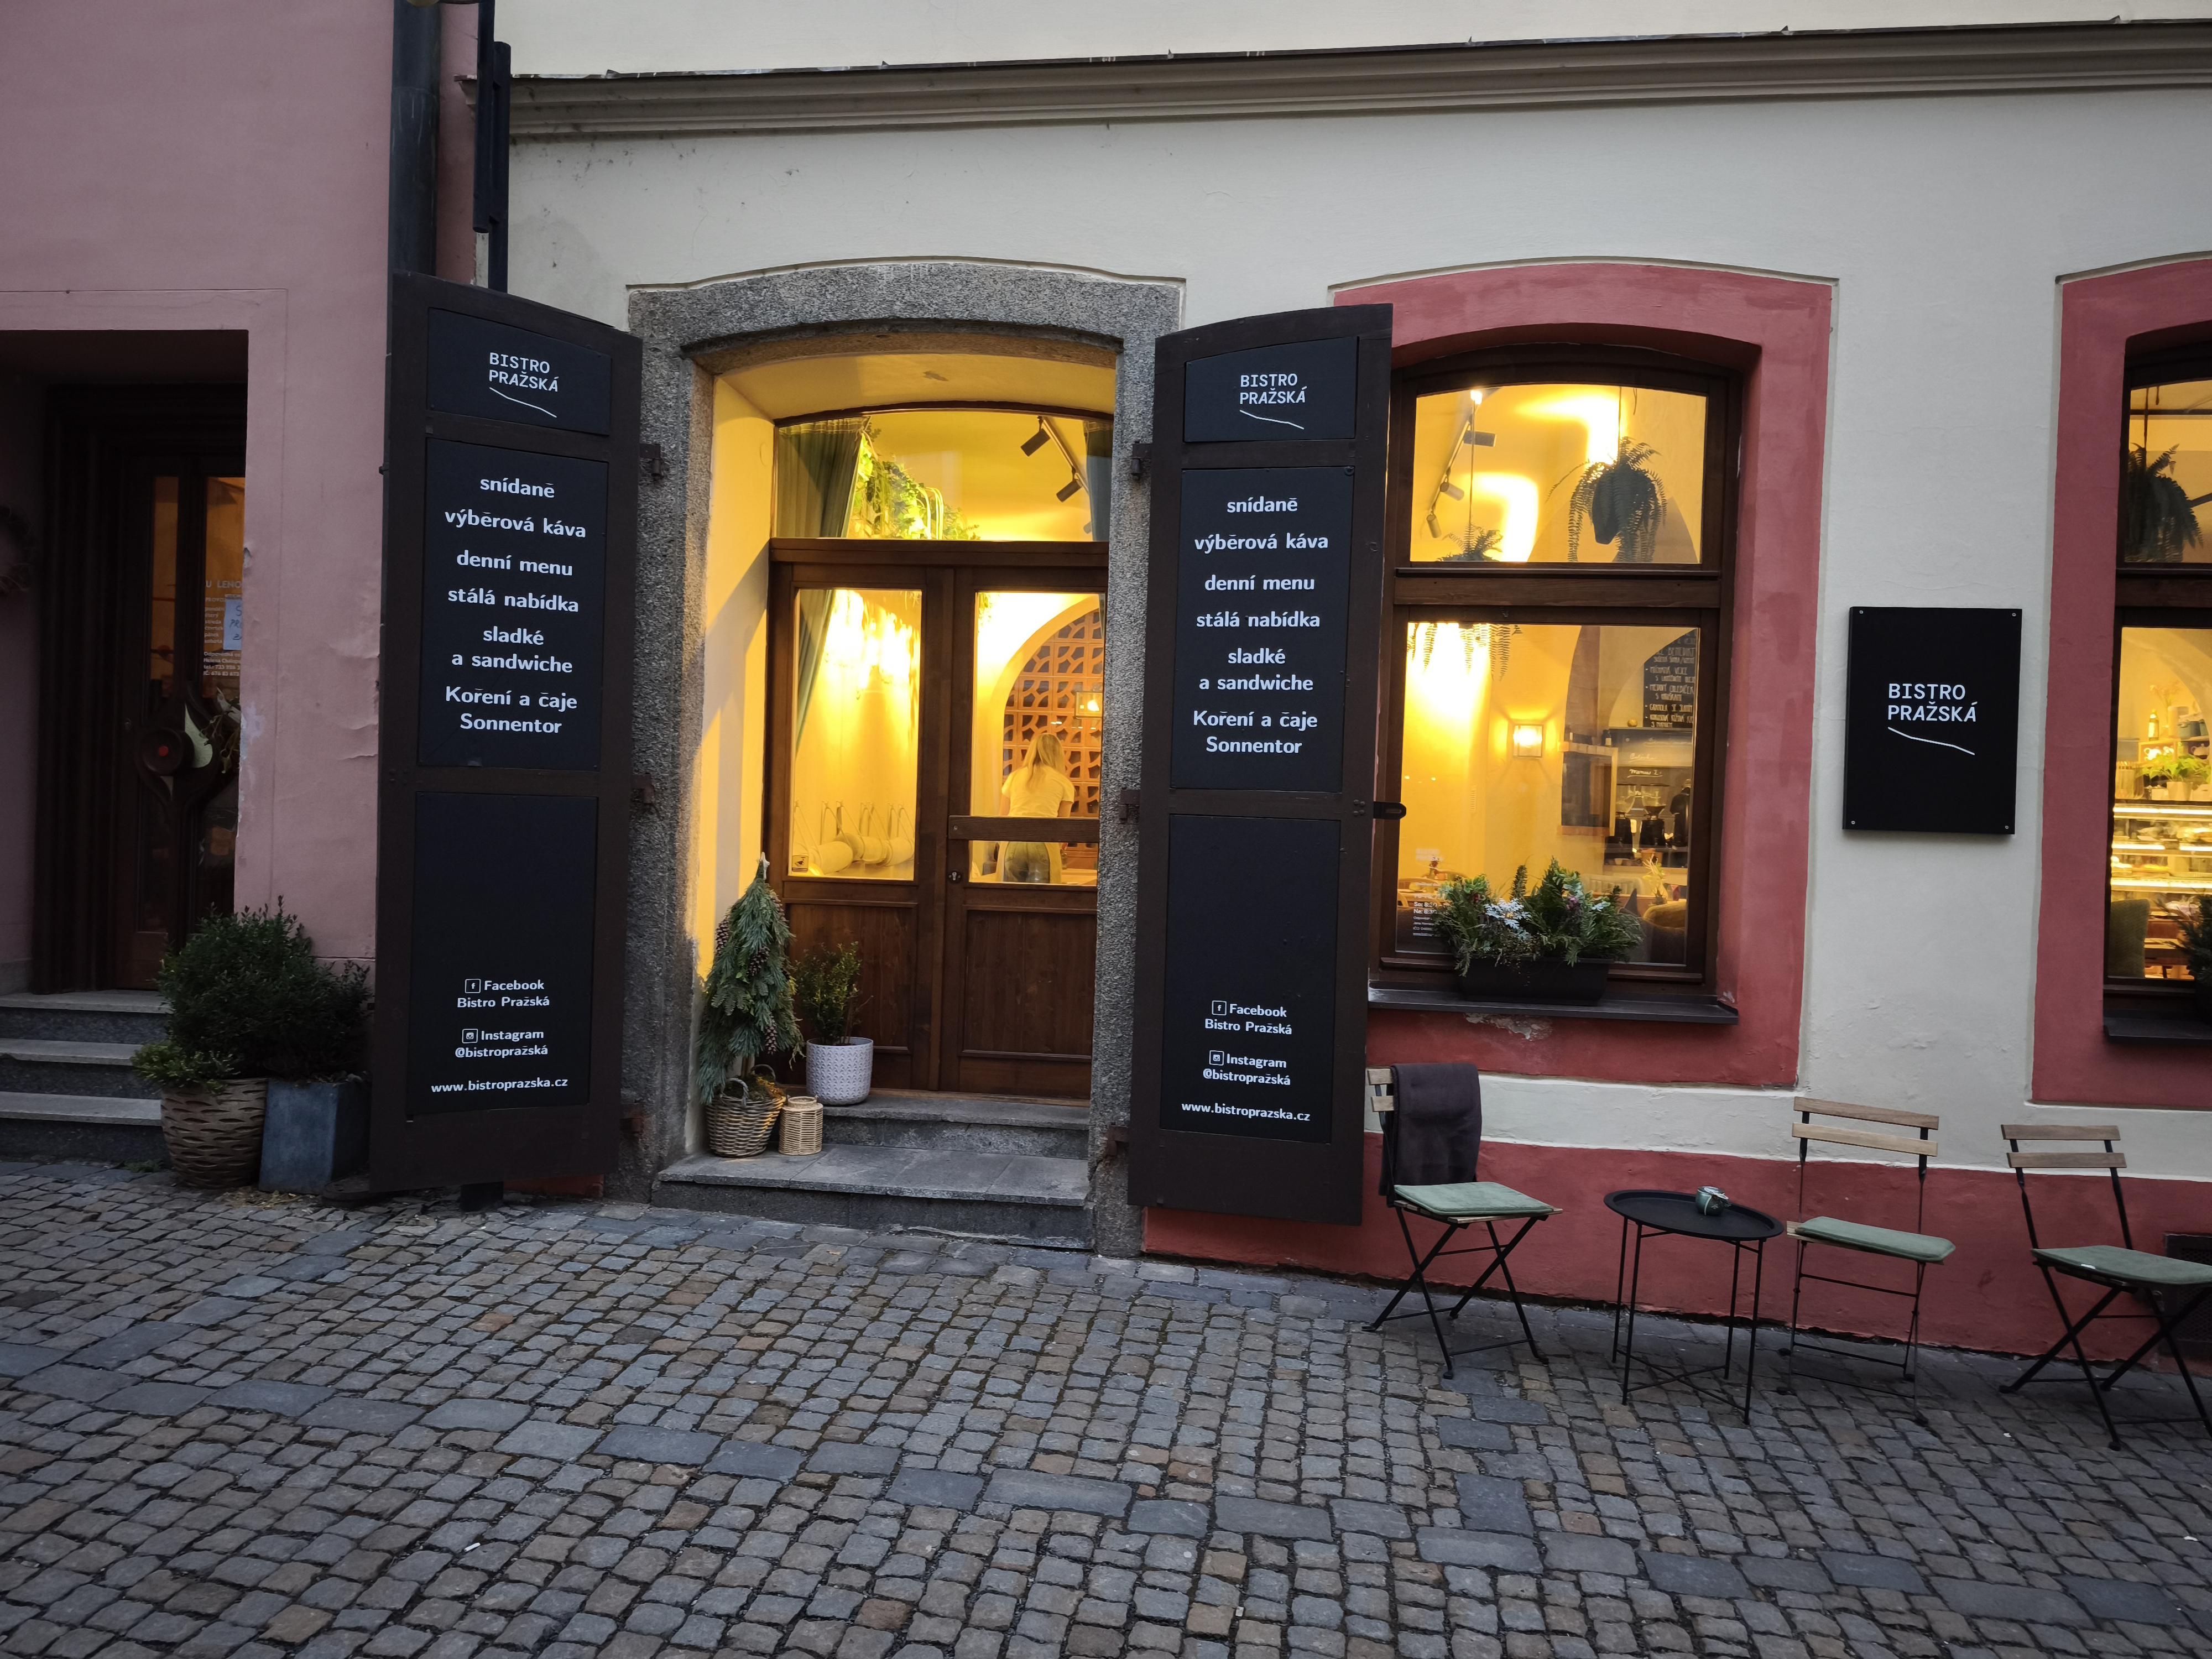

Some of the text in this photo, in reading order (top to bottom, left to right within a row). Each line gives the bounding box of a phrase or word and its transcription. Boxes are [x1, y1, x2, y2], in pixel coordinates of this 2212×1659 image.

[489, 352, 550, 374] BISTRO
[489, 368, 559, 392] PRAŽSKÁ
[1240, 373, 1298, 387] BISTRO
[1239, 385, 1307, 405] PRAŽSKÁ
[480, 477, 555, 498] snídaně
[1227, 495, 1298, 513] snídaně
[445, 509, 586, 538] výběrová káva
[1194, 532, 1328, 554] výběrová káva
[457, 549, 572, 576] denní menu
[1204, 574, 1315, 591] denní menu
[448, 587, 578, 612] stálá nabídka
[1196, 610, 1320, 627] stálá nabídka
[483, 625, 544, 645] sladké
[451, 653, 573, 673] a sandwiche
[1228, 648, 1286, 664] sladké
[1199, 674, 1313, 691] a sandwiche
[1888, 683, 1966, 700] BISTRO
[446, 686, 577, 712] Koření a čaje
[1888, 701, 1978, 722] PRAŽSKÁ
[460, 713, 562, 733] Sonnentor
[1193, 710, 1318, 732] Koření a čaje
[1206, 735, 1303, 753] Sonnentor
[484, 979, 545, 990] Facebook
[457, 995, 550, 1008] Bistro Pražská
[1229, 1003, 1287, 1018] Facebook
[1204, 1018, 1292, 1035] Bistro Pražská
[481, 1030, 544, 1042] Instagram
[455, 1045, 548, 1058] @bistropražská
[1227, 1053, 1287, 1069] Instagram
[431, 1077, 568, 1093] www.bistroprazska.cz
[1203, 1068, 1291, 1086] @bistropražská
[1181, 1102, 1311, 1121] www.bistroprazska.cz
